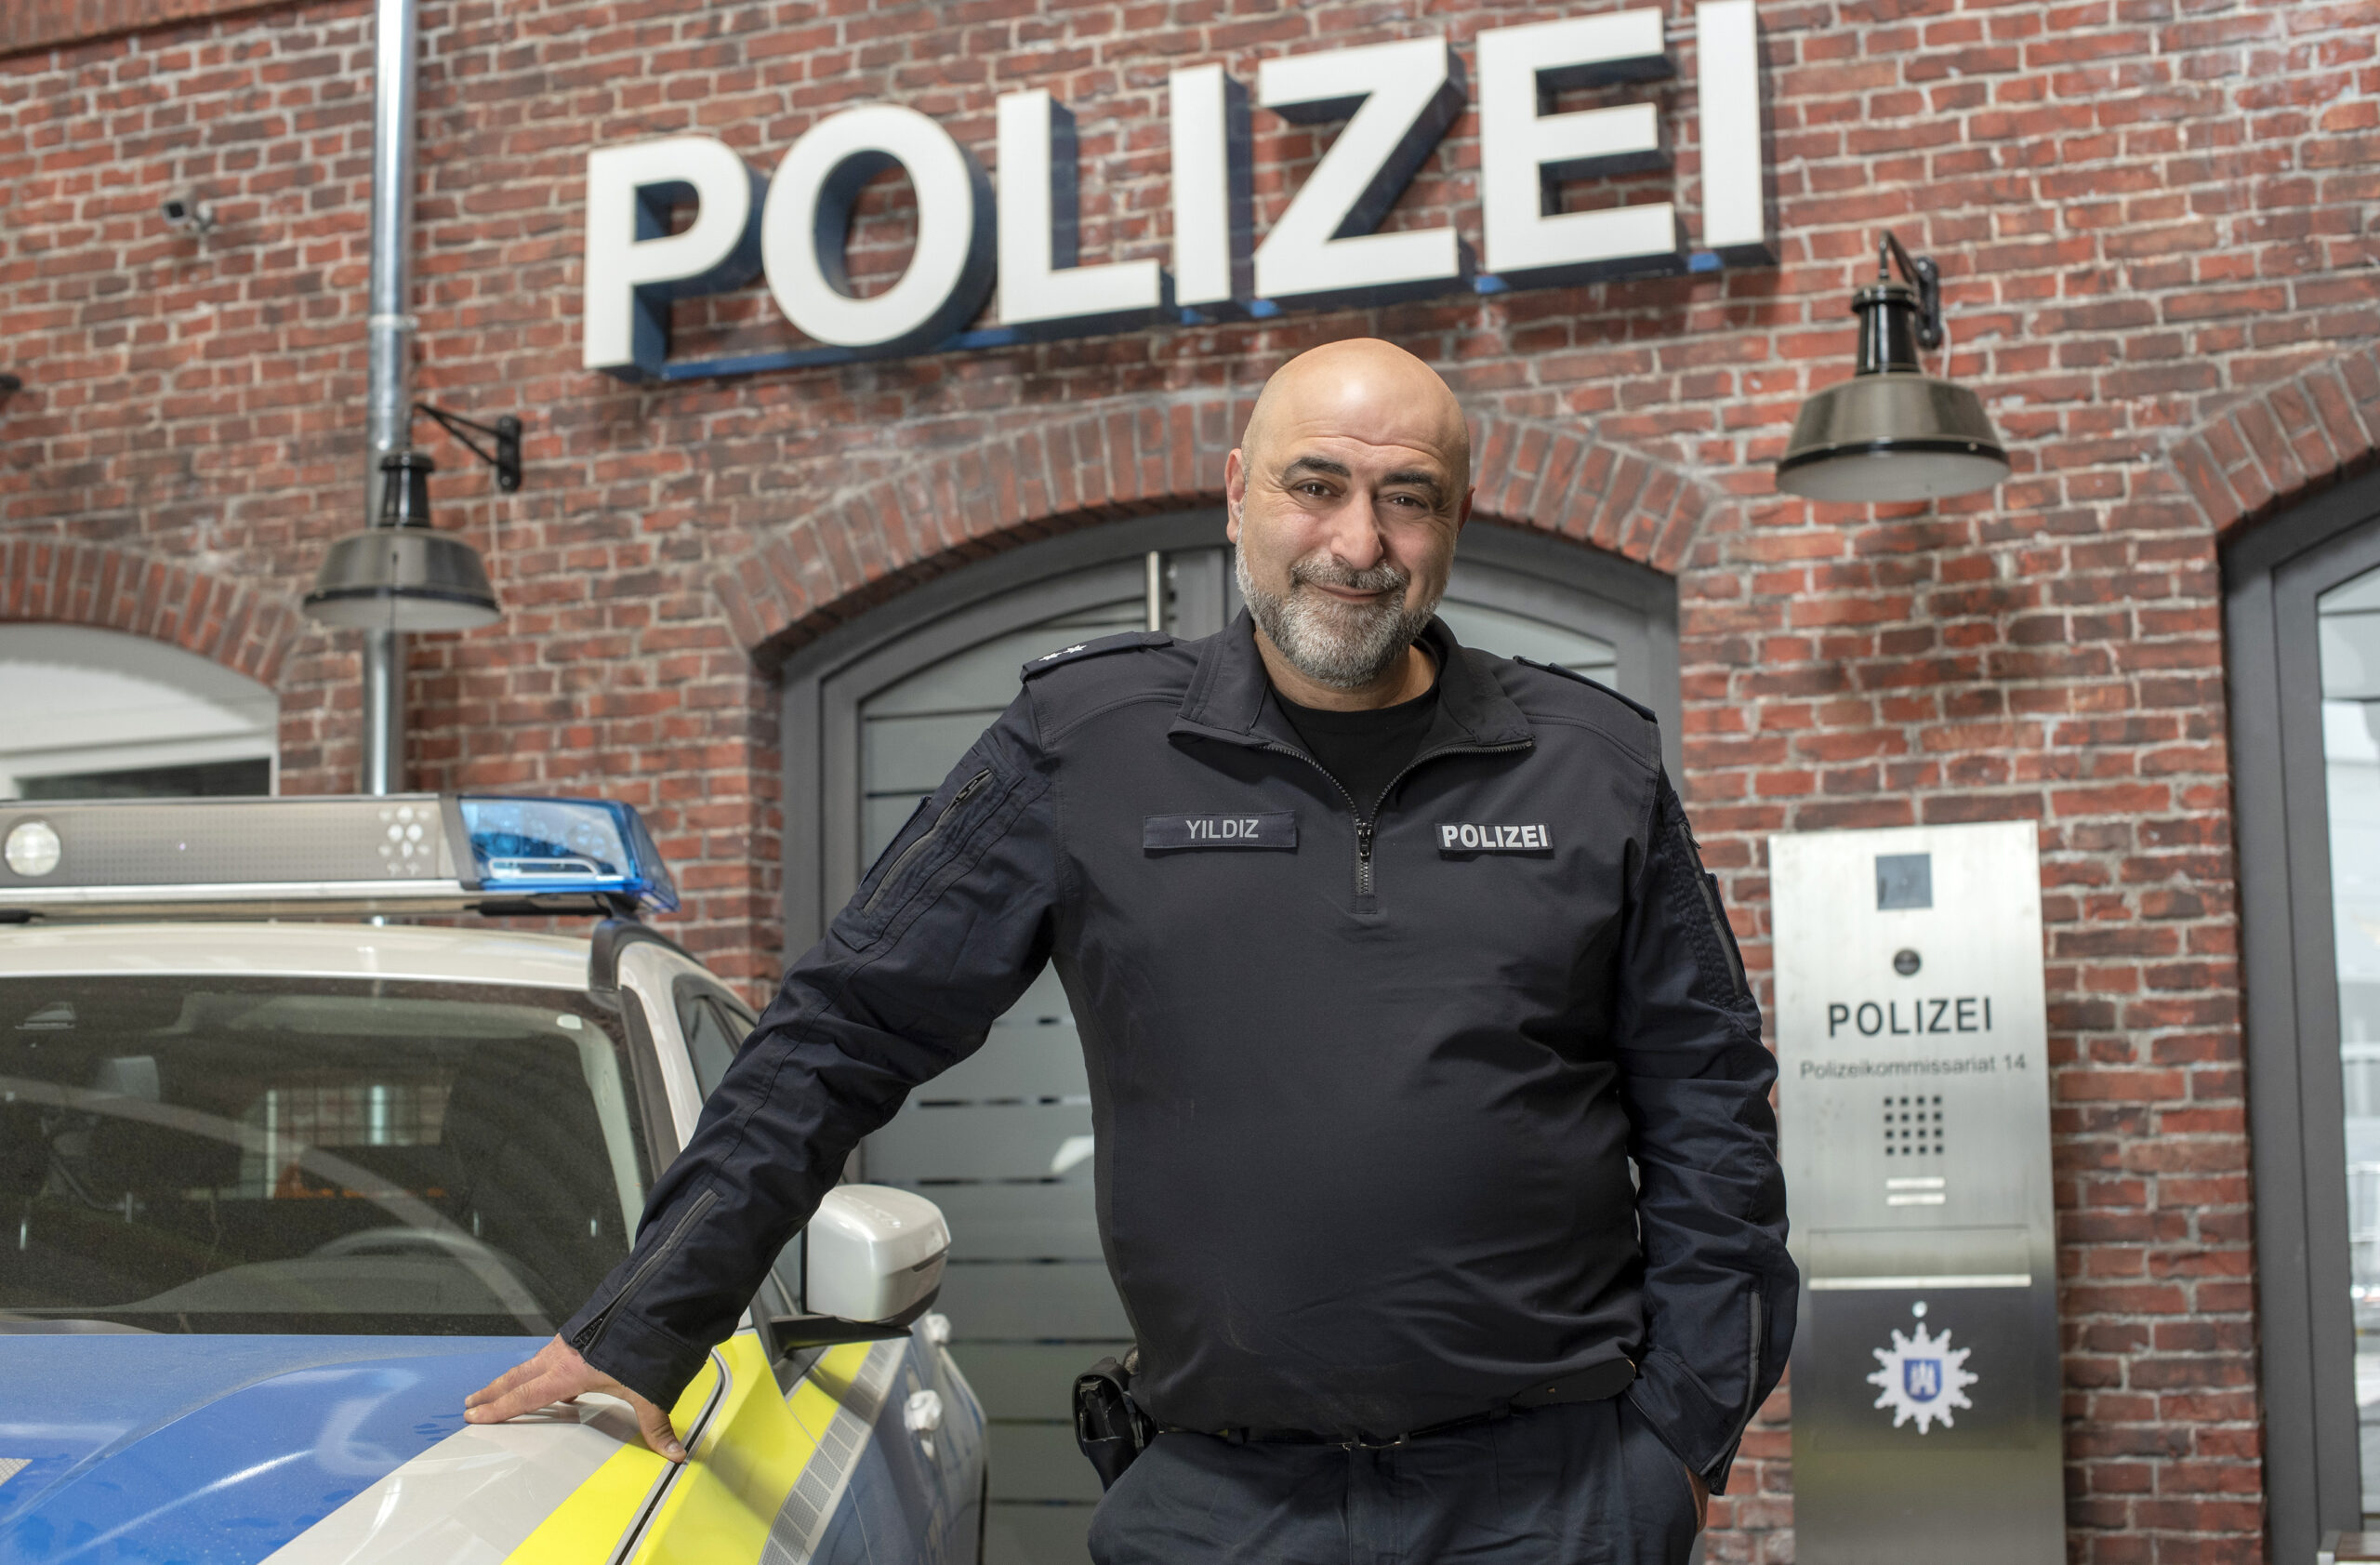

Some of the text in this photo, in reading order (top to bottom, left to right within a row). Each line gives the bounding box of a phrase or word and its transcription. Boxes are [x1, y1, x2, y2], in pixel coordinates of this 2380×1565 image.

[583, 0, 1763, 370] POLIZEI
[1185, 819, 1259, 839] YILDIZ
[1441, 824, 1548, 848] POLIZEI
[1828, 996, 1992, 1038] POLIZEI
[1800, 1054, 2028, 1080] Polizeikommissariat 14
